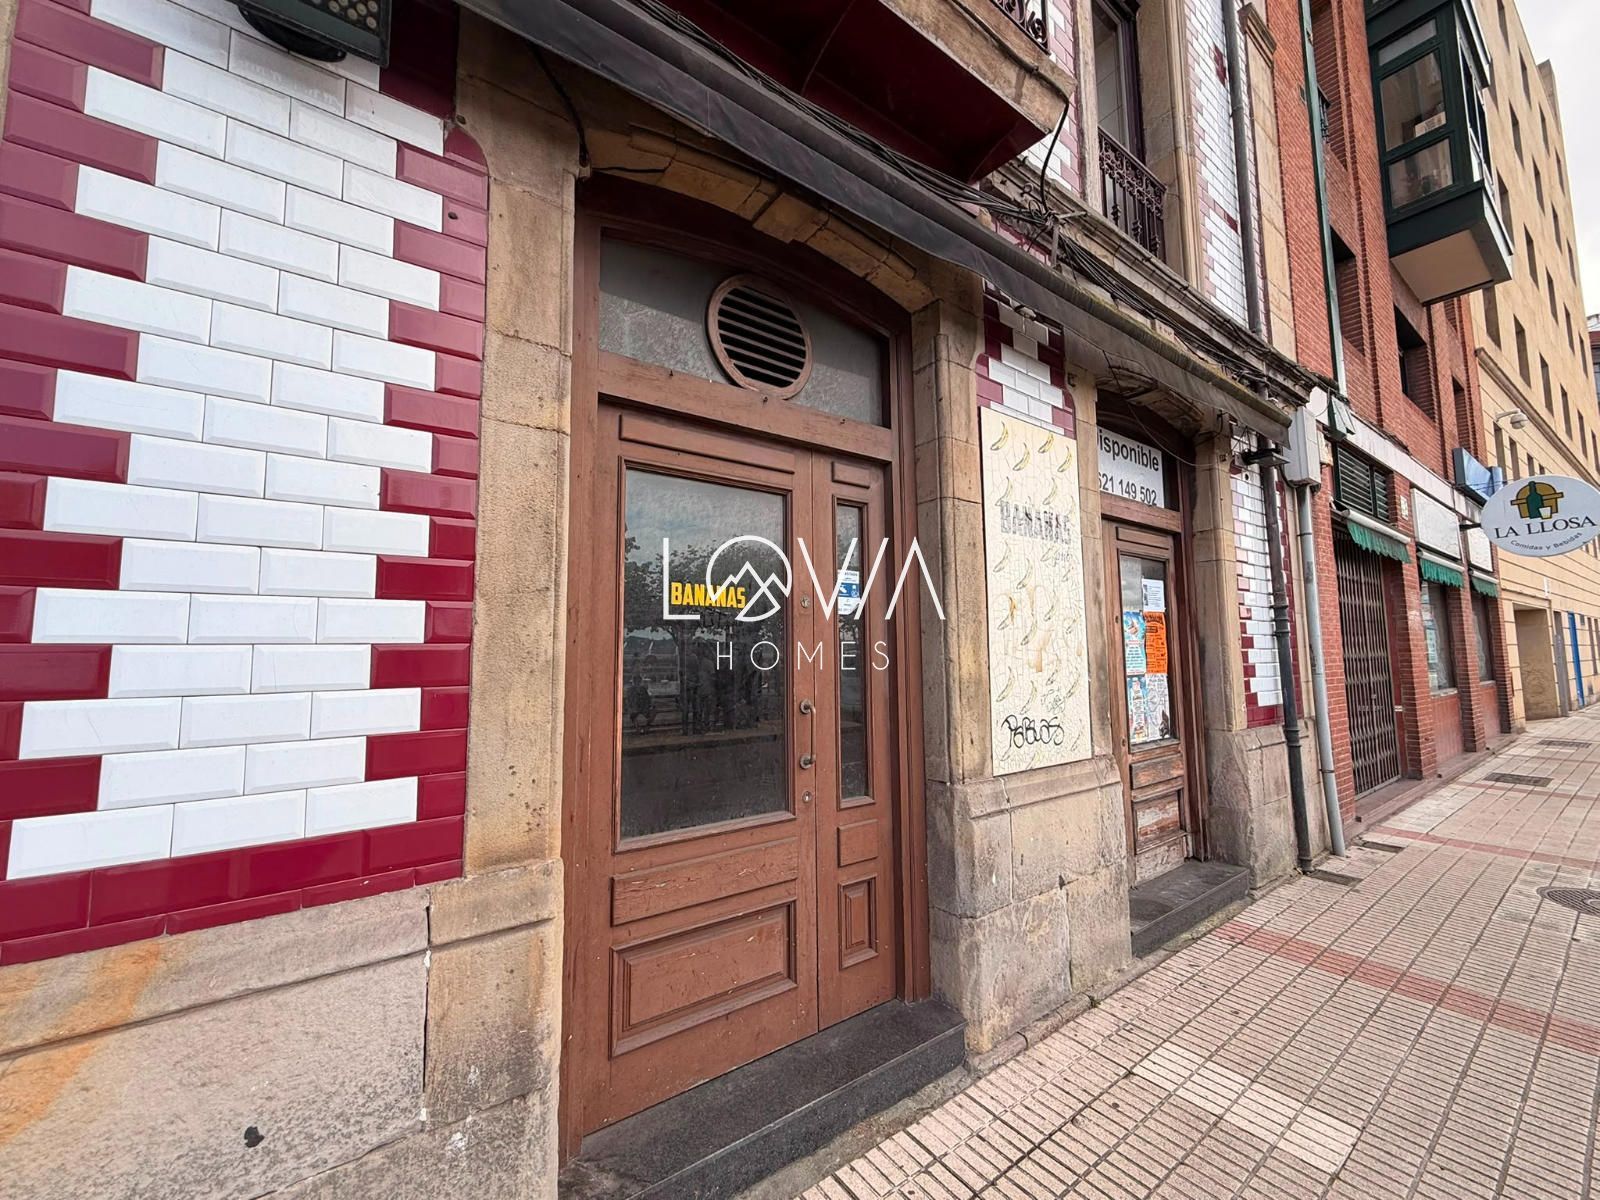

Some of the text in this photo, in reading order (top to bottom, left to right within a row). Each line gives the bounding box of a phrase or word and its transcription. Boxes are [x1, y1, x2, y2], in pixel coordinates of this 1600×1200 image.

[1096, 429, 1160, 472] isponible
[1119, 479, 1137, 500] 149
[1140, 486, 1158, 506] 502
[1494, 515, 1597, 538] LA LLOSA
[1510, 540, 1543, 551] Comidas
[1553, 532, 1583, 548] Bebidas
[671, 582, 747, 609] BANANAS
